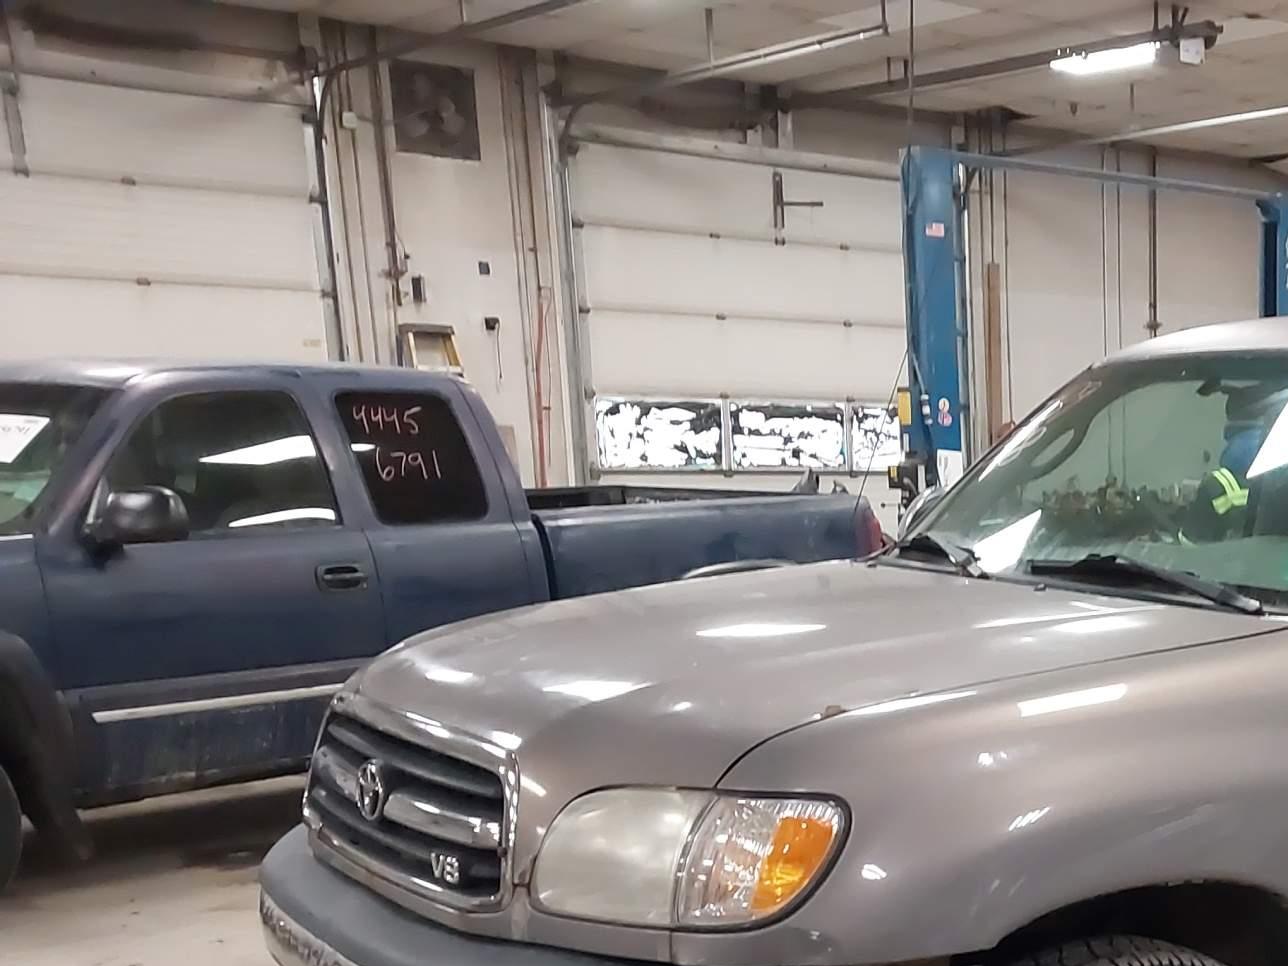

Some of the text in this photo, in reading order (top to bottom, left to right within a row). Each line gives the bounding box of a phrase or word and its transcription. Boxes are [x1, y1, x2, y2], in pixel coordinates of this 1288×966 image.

[352, 405, 422, 434] 4445
[376, 447, 441, 481] 6791
[431, 852, 460, 885] V8
